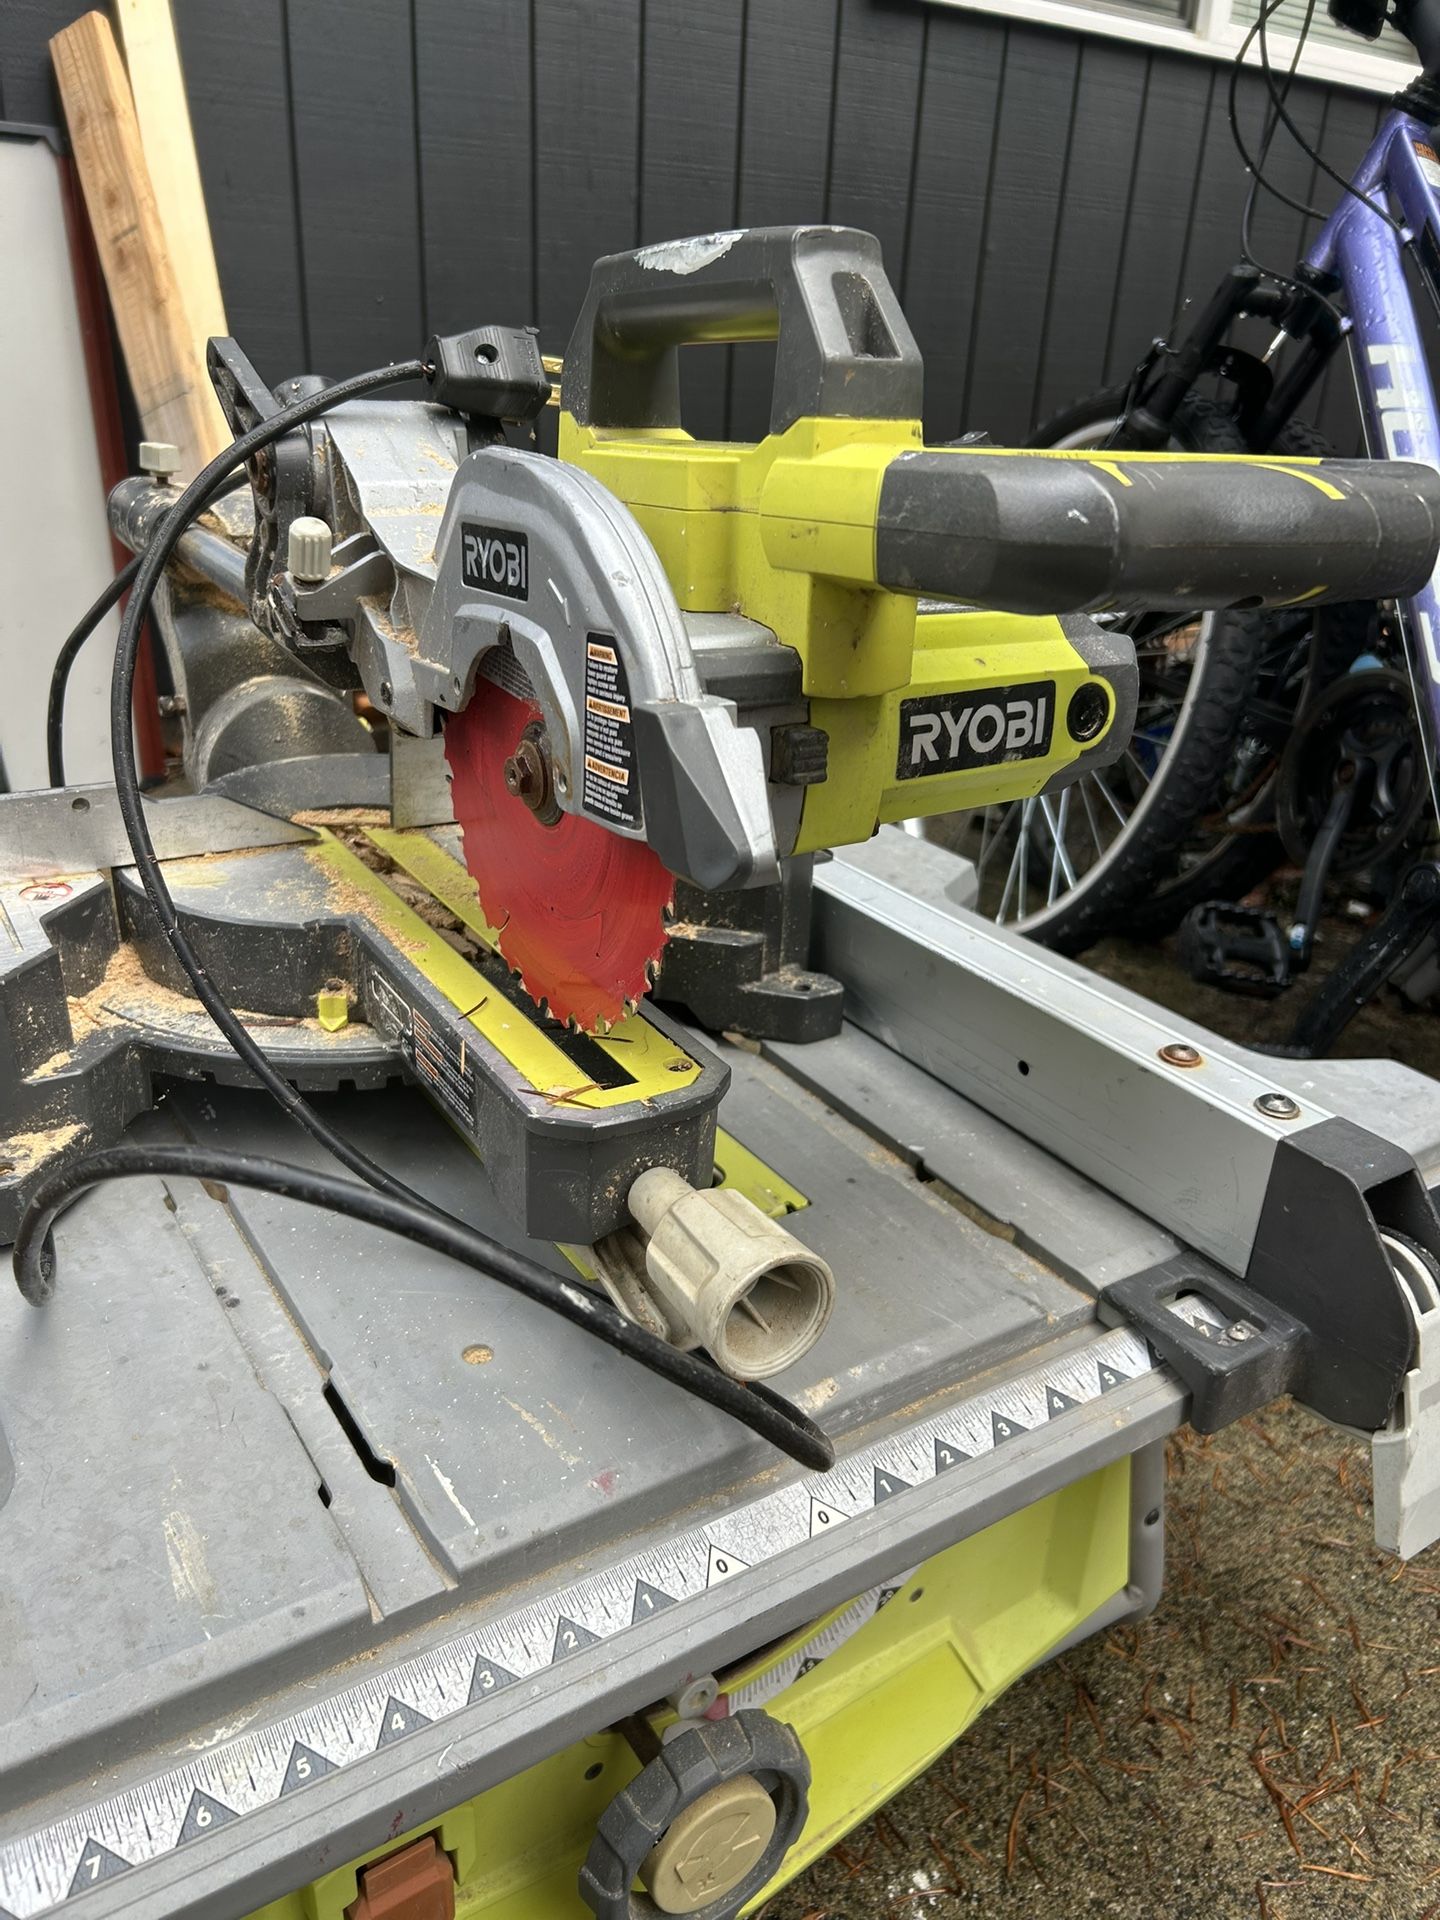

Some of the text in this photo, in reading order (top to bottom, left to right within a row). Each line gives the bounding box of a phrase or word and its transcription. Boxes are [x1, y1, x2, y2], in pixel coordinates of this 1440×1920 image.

[464, 534, 526, 588] RYOBI
[592, 700, 626, 718] AVERTISSEMENT
[910, 697, 1046, 764] RYOBI
[592, 761, 625, 781] ADVERTENCIA
[818, 1372, 1116, 1524] 0 1 2 3 4 5
[85, 1559, 728, 1880] 7 6 5 4 3 2 1 0
